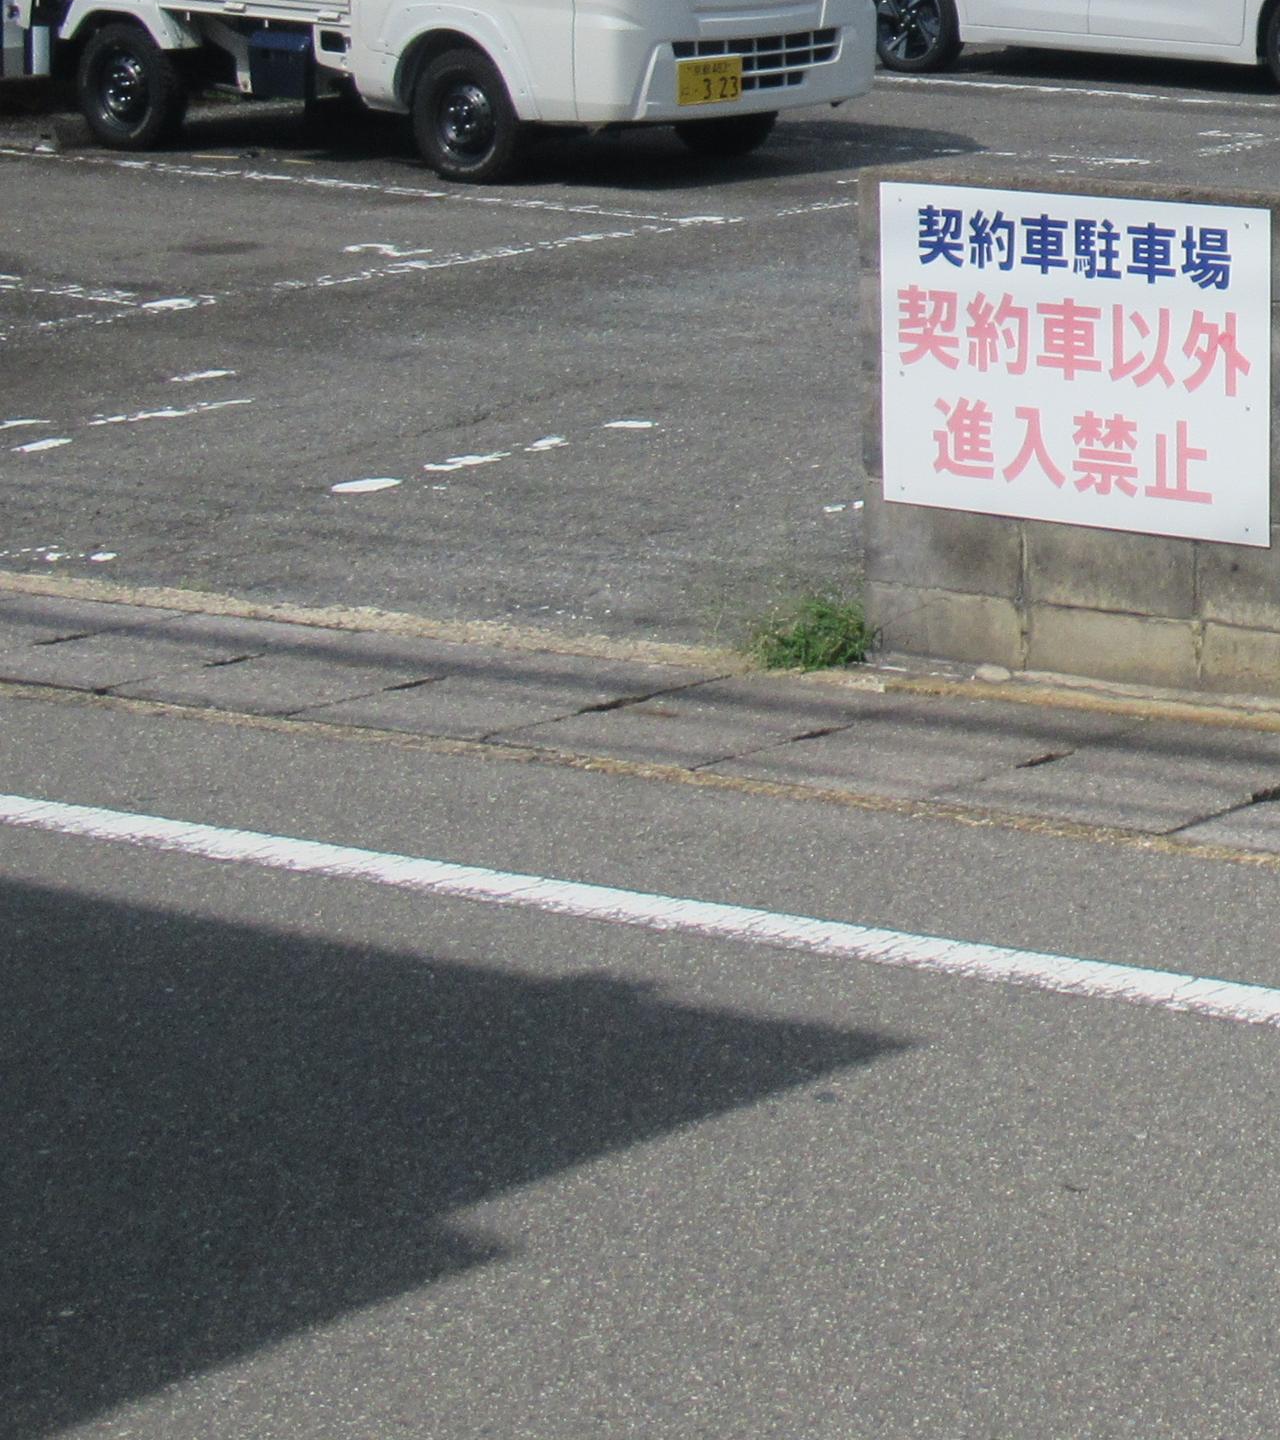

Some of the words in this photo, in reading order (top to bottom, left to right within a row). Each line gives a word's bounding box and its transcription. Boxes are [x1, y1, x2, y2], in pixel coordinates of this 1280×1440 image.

[917, 203, 1233, 290] 契約車駐車場
[897, 284, 1252, 398] 契約車以外
[932, 396, 1213, 505] 進入禁止
